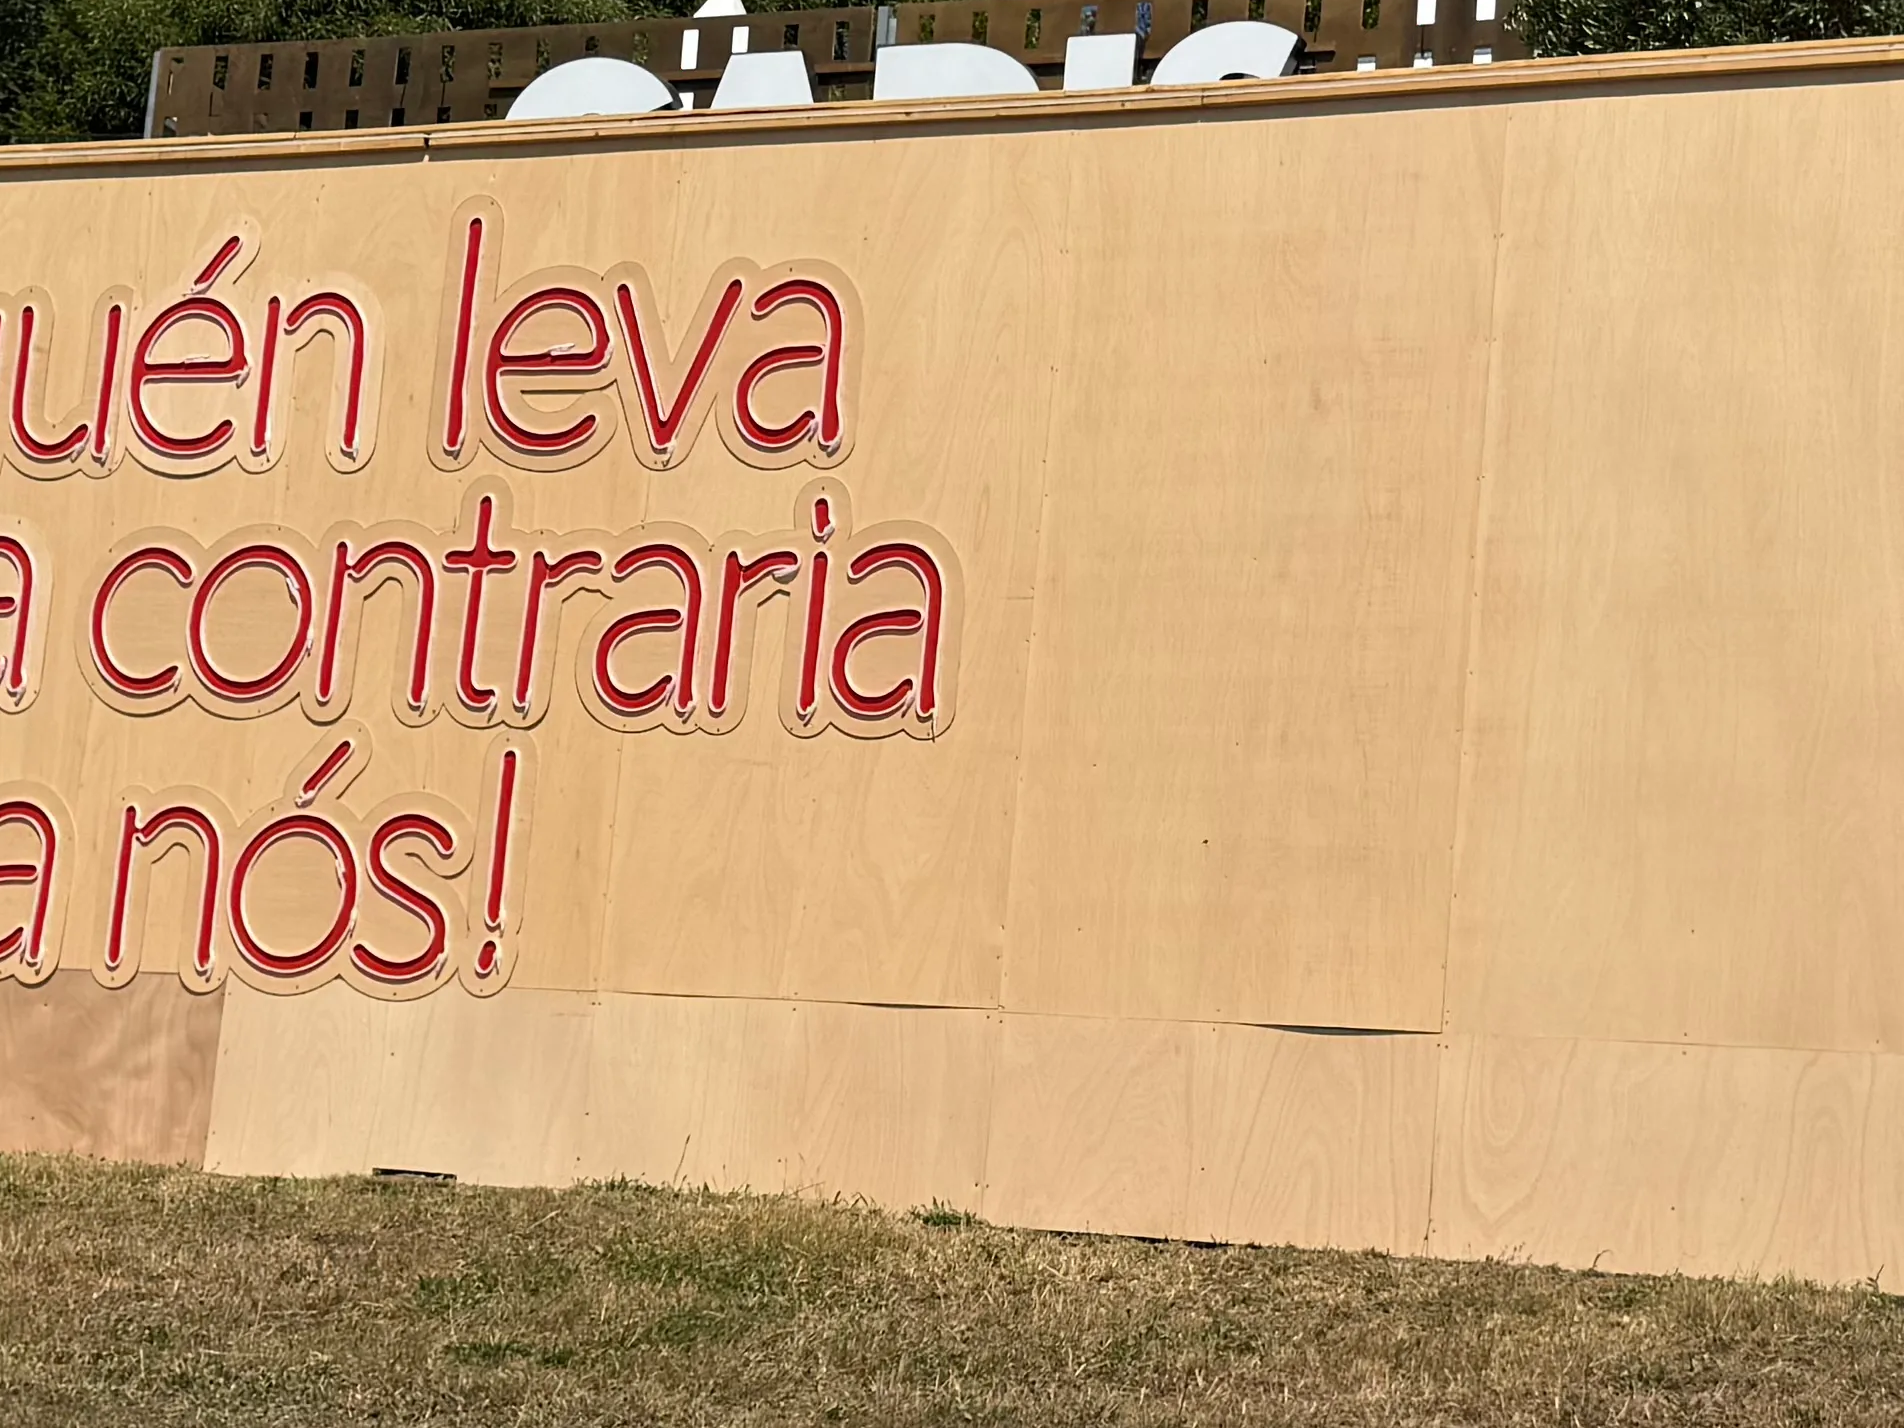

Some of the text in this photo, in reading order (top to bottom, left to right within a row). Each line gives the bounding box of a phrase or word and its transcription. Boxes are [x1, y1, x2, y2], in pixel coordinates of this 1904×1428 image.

[441, 217, 847, 452] leva
[88, 496, 947, 719] contraria
[104, 740, 521, 981] nós!
